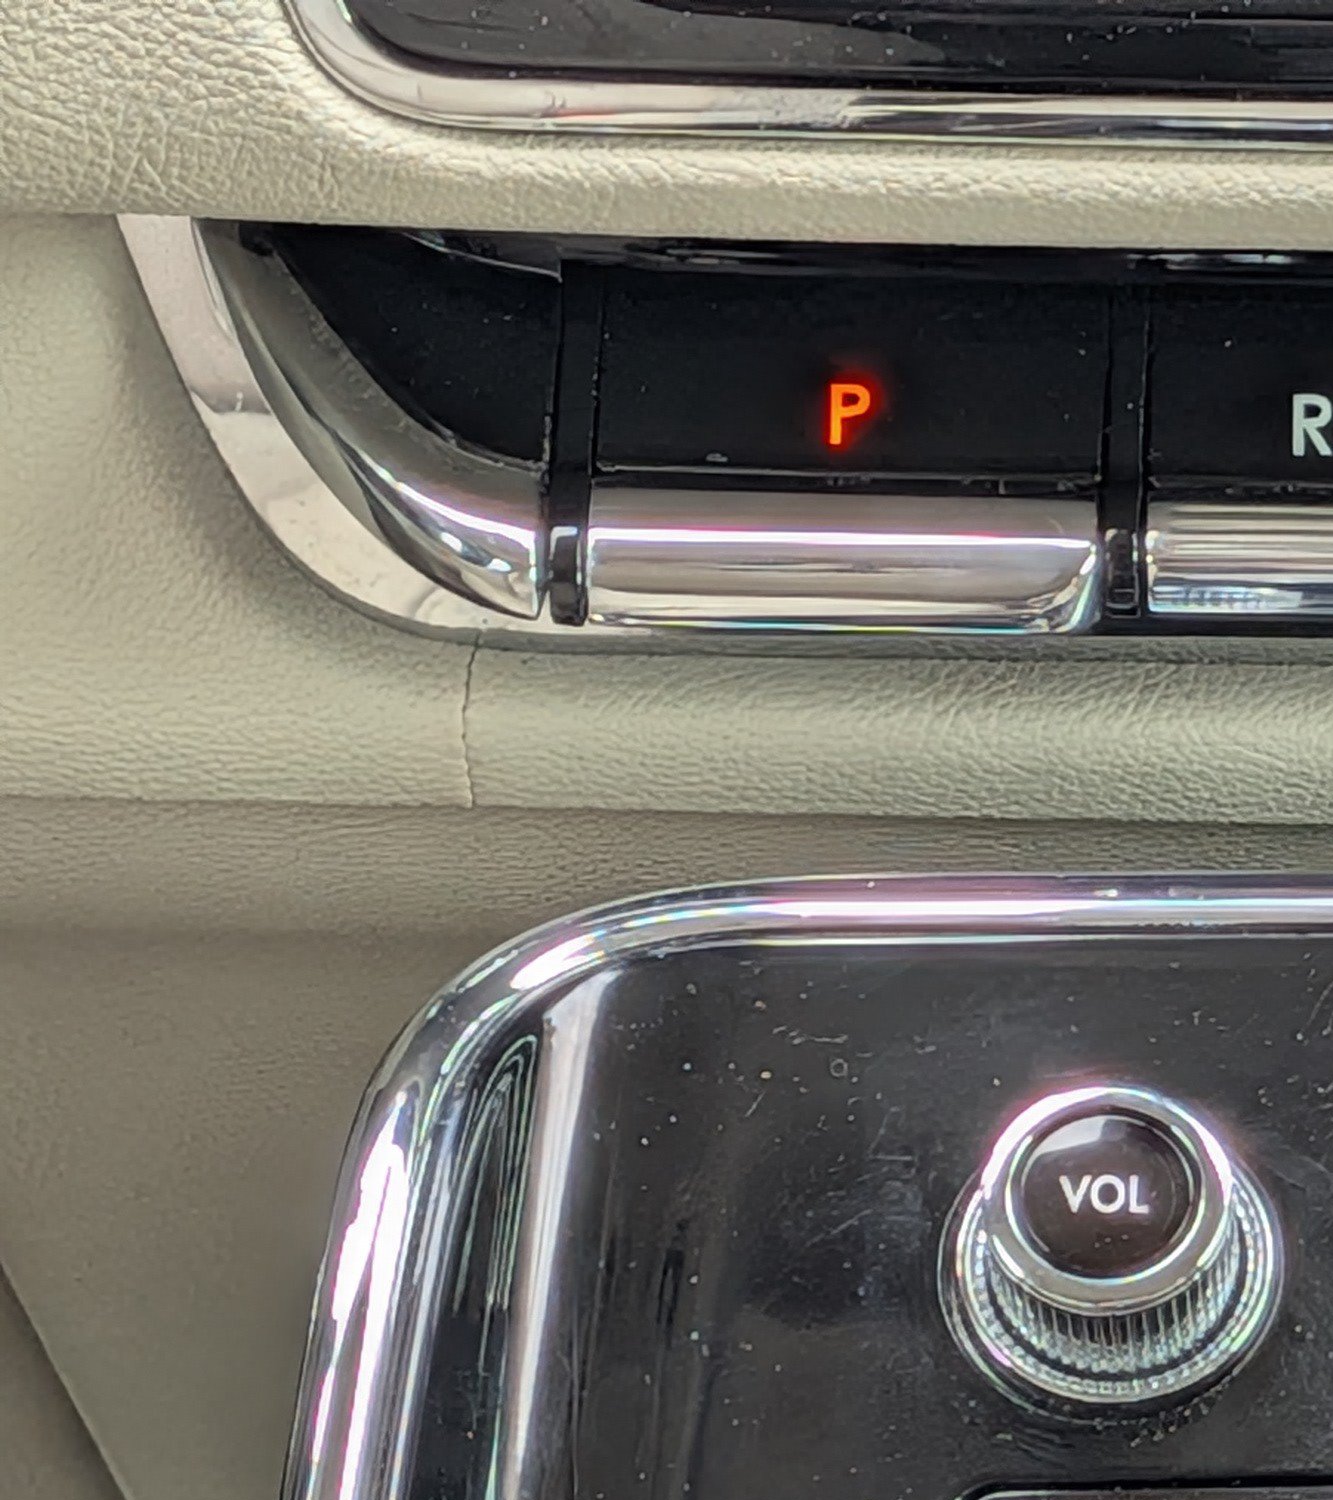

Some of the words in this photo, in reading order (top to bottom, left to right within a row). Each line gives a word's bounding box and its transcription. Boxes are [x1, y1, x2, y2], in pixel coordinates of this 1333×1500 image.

[825, 382, 874, 447] P
[1291, 393, 1333, 457] R
[1058, 1174, 1150, 1214] VOL
